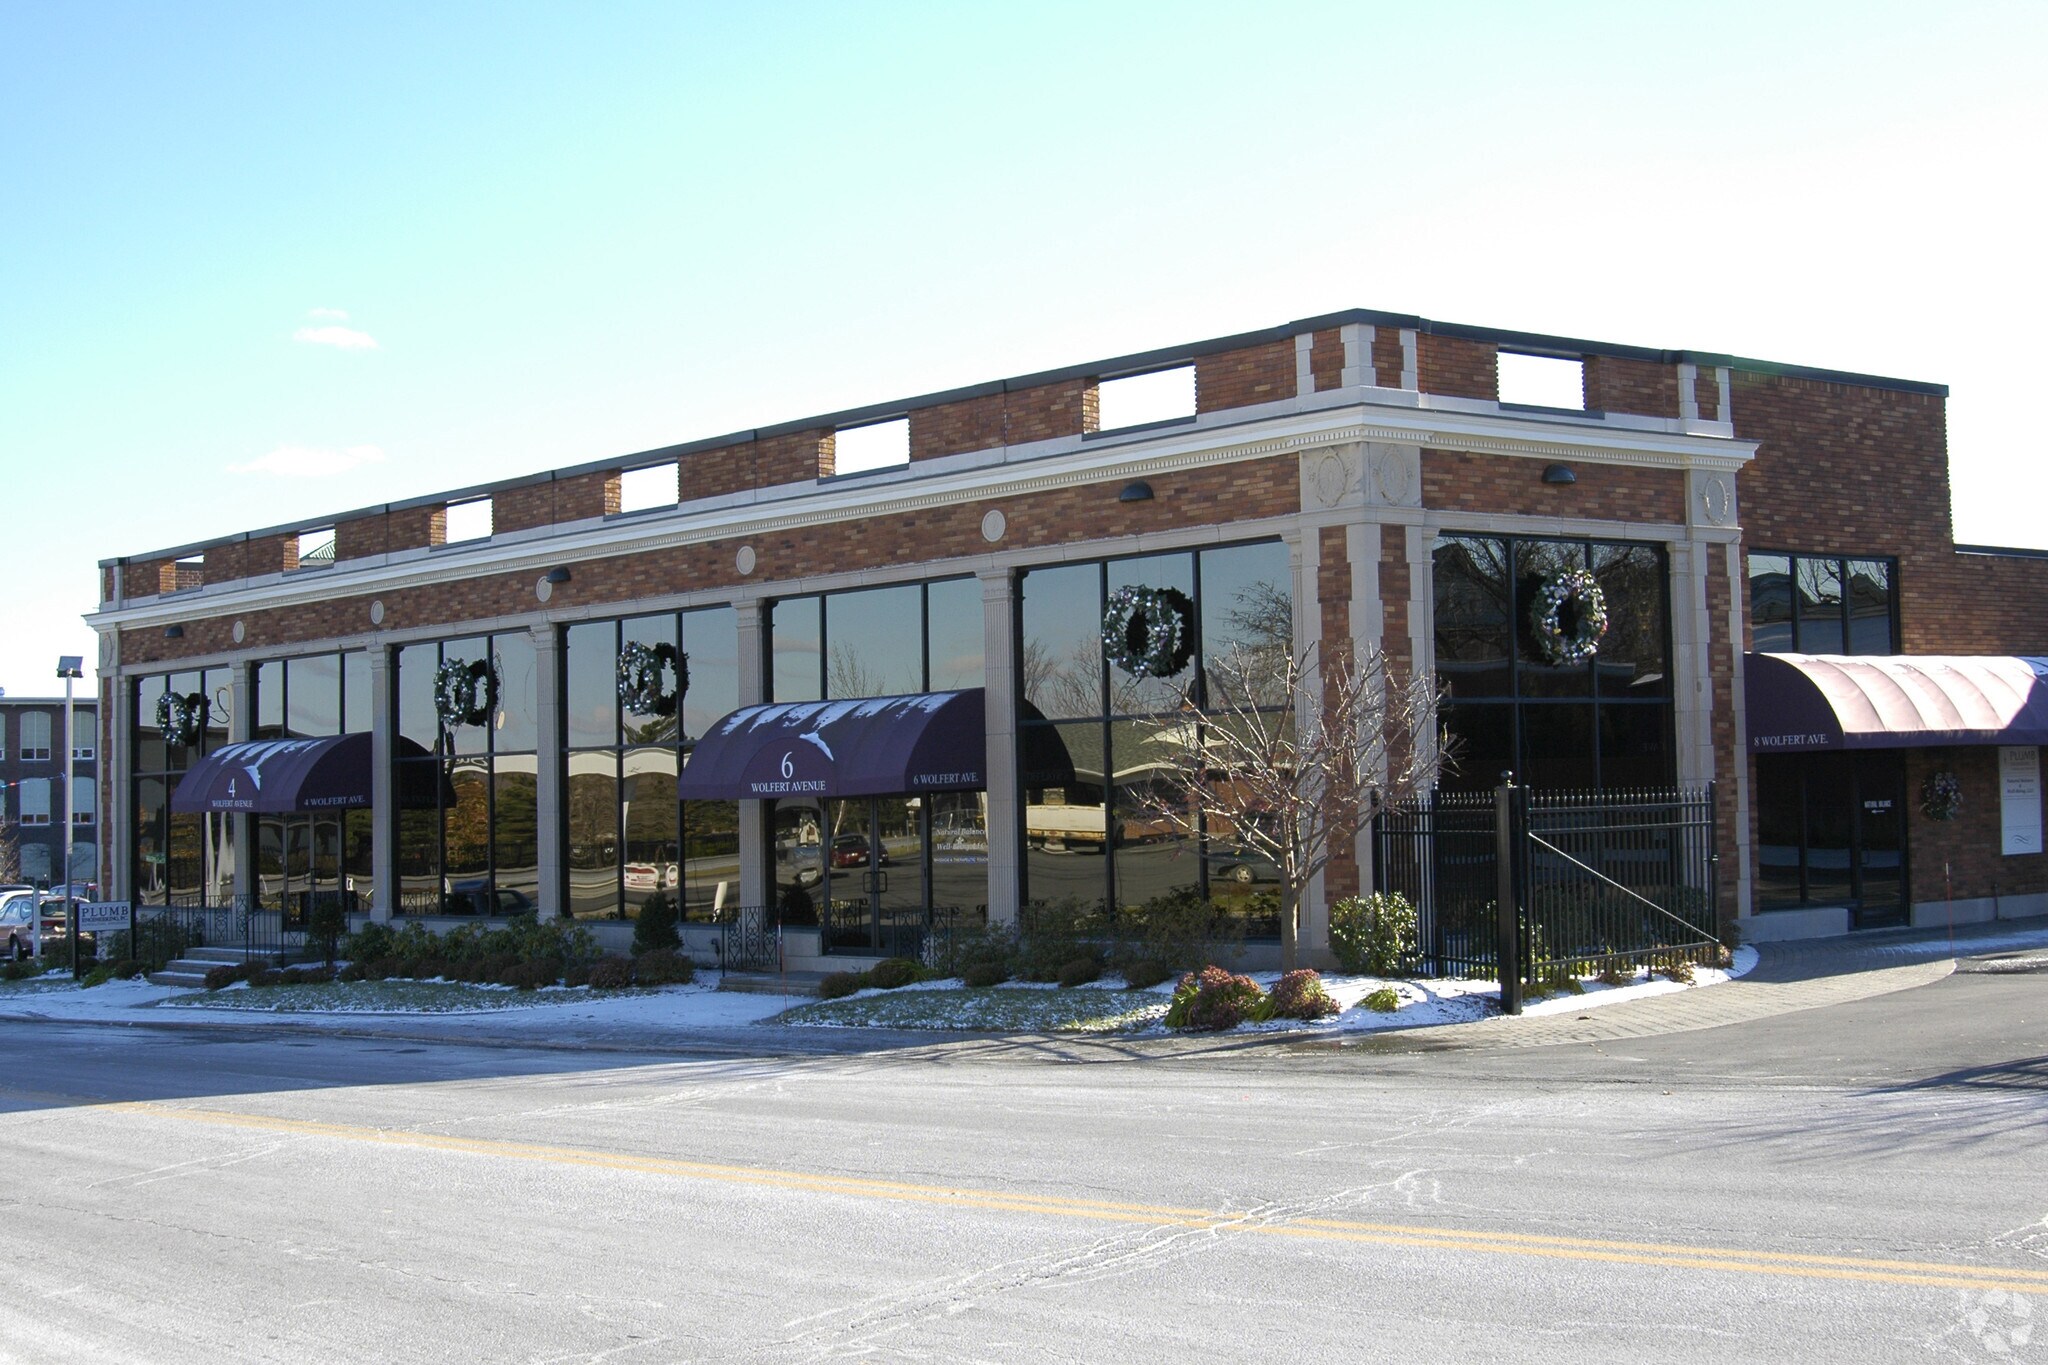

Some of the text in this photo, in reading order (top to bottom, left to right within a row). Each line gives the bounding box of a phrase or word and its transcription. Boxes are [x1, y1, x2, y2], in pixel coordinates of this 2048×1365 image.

[1754, 733, 1829, 747] 8 WOLFERT AVE.
[781, 751, 794, 779] 6
[913, 771, 979, 785] 6 WOLFERT AVE.
[228, 777, 236, 798] 4
[751, 780, 826, 793] WOLFERT AVENUE
[212, 799, 254, 808] WOLFERT AVENUE
[304, 794, 366, 807] 4 WOLFERT AVE.
[82, 906, 129, 917] PLUMB
